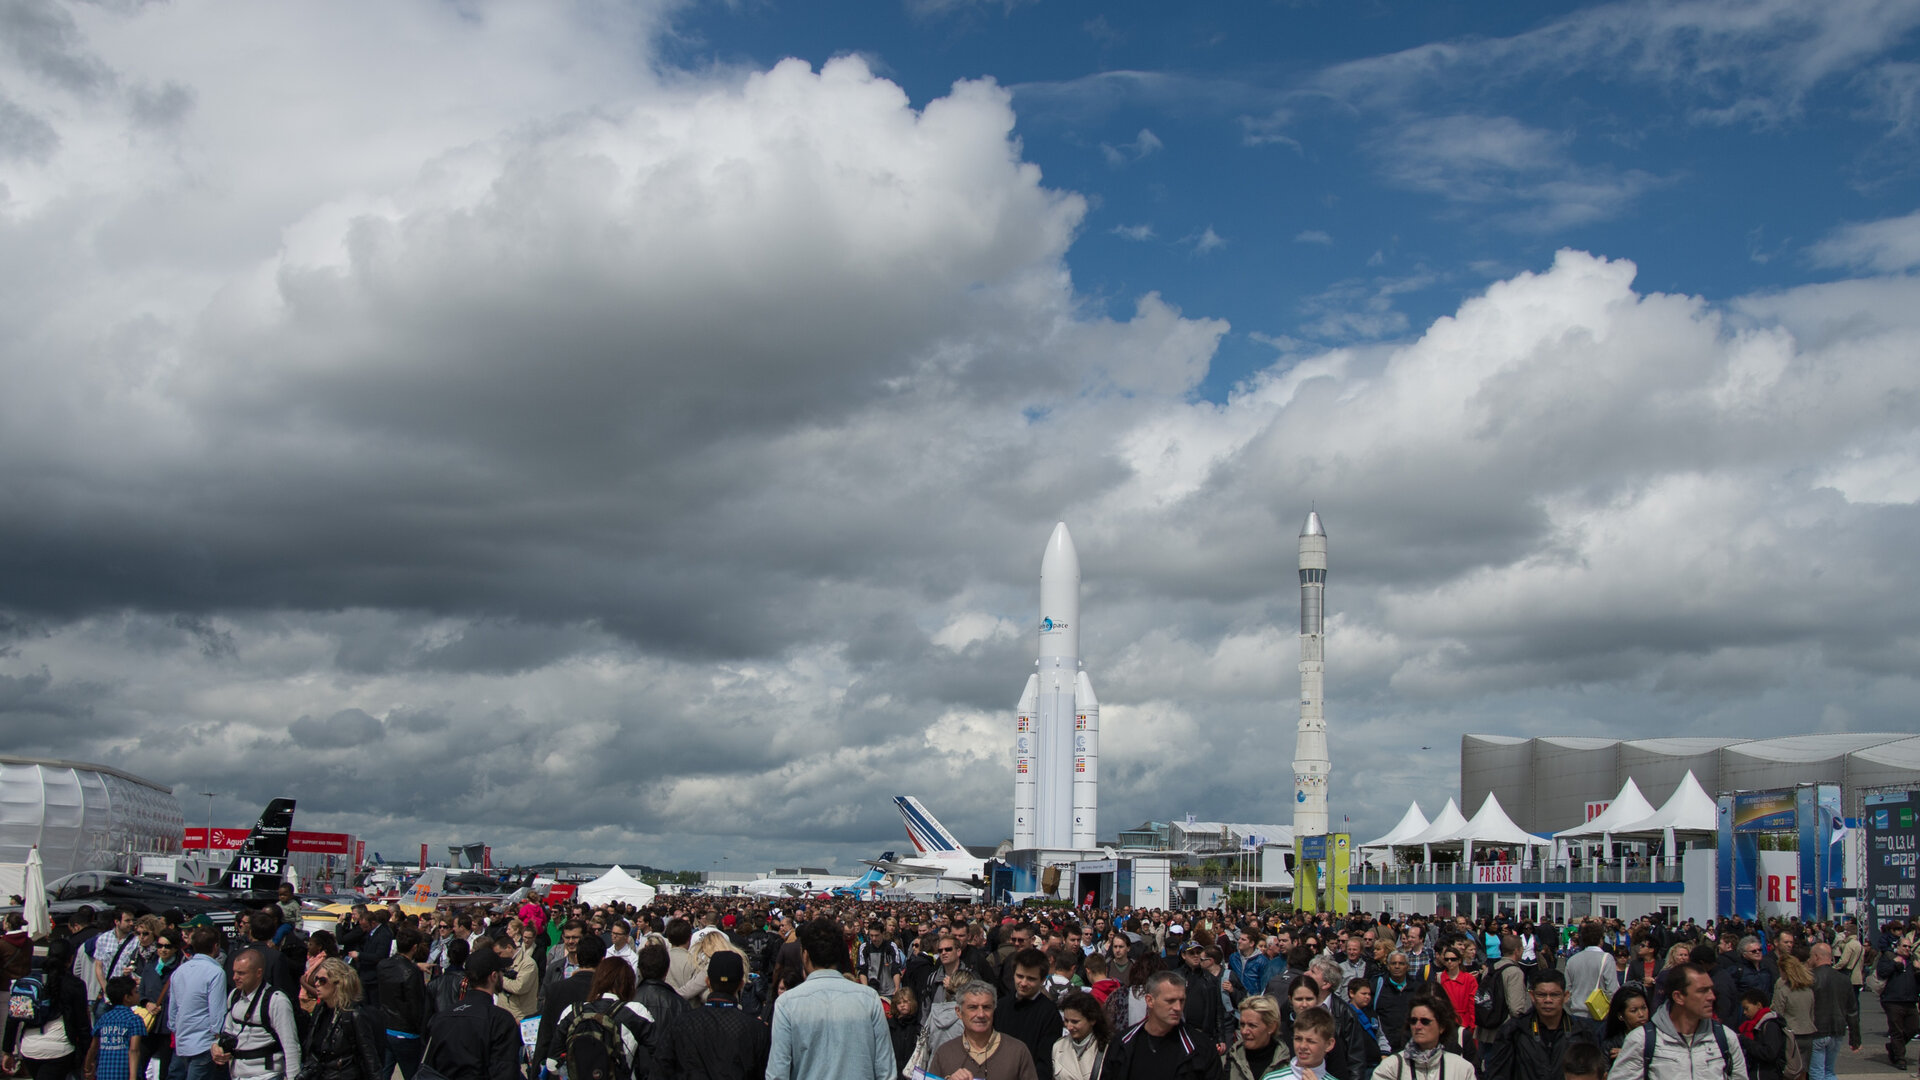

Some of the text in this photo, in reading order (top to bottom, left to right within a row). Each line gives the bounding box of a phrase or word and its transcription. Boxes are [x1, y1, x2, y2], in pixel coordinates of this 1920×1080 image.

[1907, 834, 1915, 849] L4
[240, 857, 278, 873] M 345
[231, 873, 254, 889] HET
[1480, 866, 1512, 882] PRESSE
